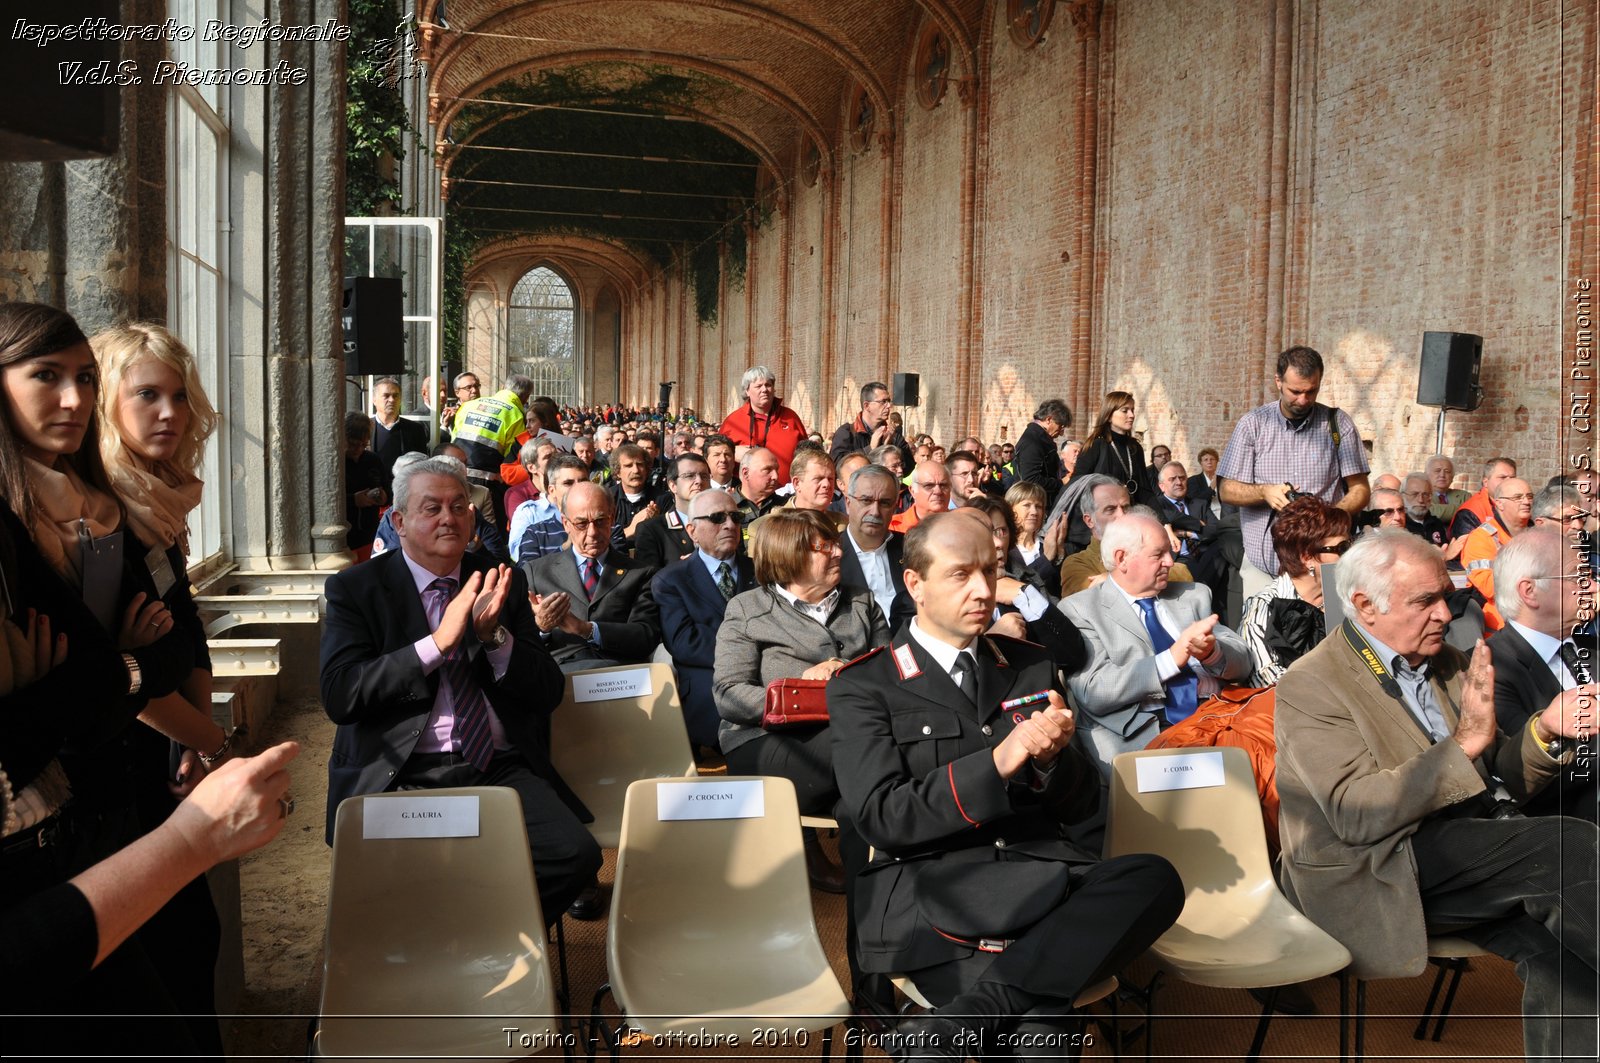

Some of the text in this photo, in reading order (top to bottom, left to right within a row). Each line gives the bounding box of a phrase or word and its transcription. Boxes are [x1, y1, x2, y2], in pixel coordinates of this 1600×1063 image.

[1361, 648, 1385, 675] Nikon
[588, 686, 624, 694] FONDAZIONE
[696, 793, 733, 801] CROCIANI
